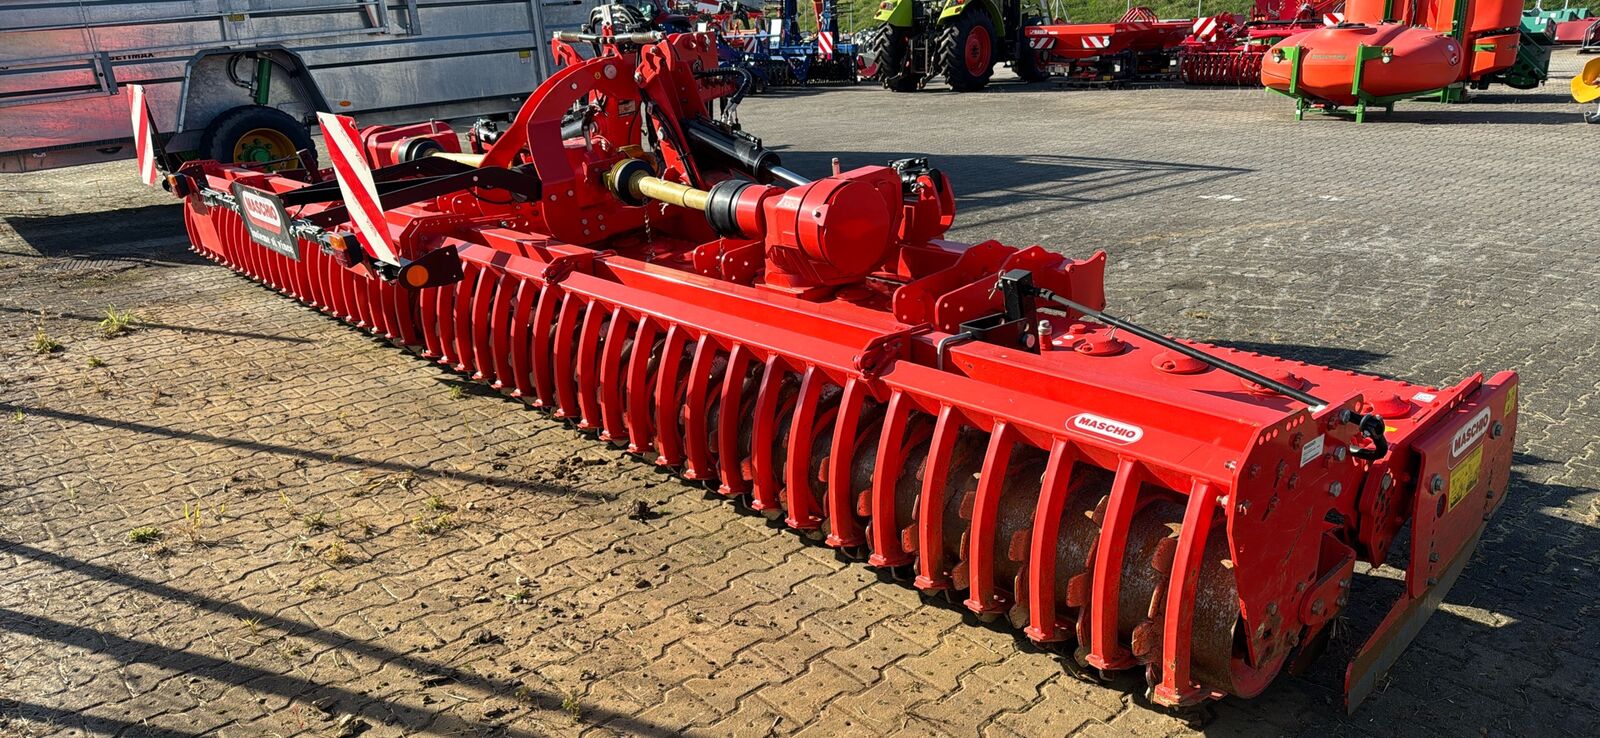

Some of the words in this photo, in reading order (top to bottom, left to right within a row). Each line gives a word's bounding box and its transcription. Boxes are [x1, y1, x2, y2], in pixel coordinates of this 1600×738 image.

[244, 195, 278, 221] MASCHIO
[1078, 416, 1137, 439] MASCHIO
[1453, 412, 1489, 451] MASCHIO
